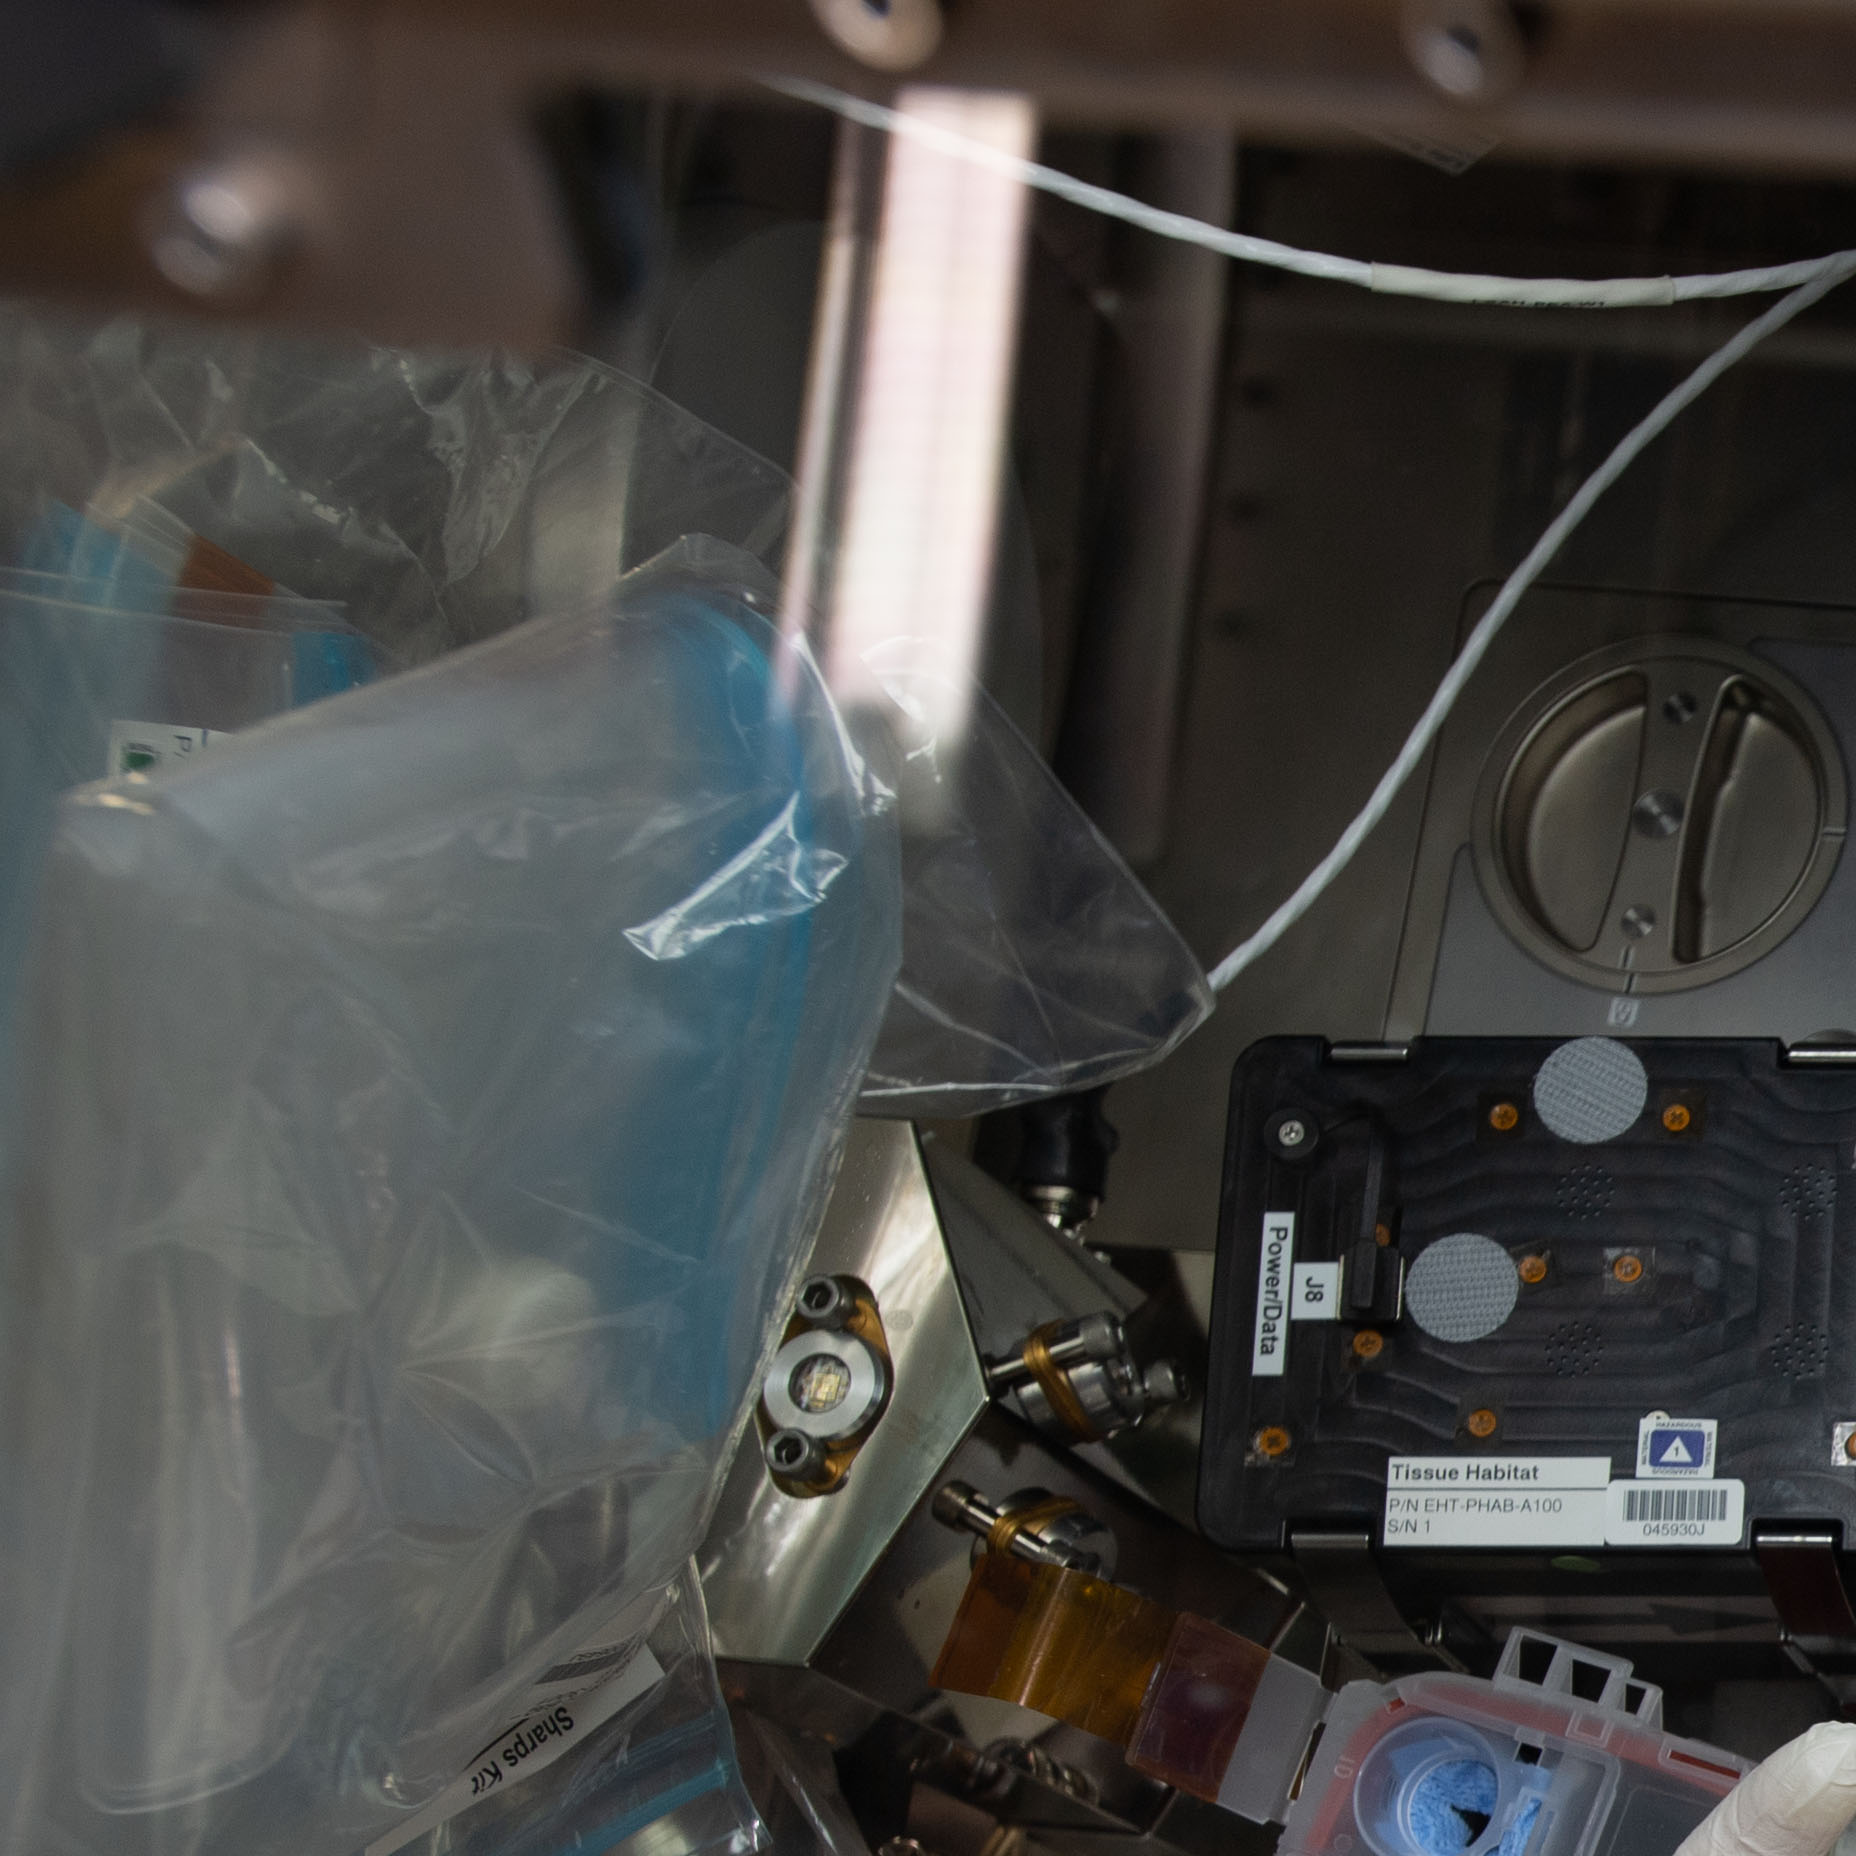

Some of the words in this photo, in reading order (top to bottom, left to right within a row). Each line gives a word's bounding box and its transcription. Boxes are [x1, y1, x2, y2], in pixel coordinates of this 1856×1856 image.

[1259, 1225, 1288, 1356] Power/Data
[1304, 1276, 1324, 1303] J8
[1393, 1465, 1459, 1481] Tissue
[1466, 1464, 1538, 1480] Habitat
[1389, 1498, 1418, 1512] P/N
[1424, 1497, 1562, 1514] EHT-PHAB-A100
[1387, 1519, 1417, 1534] S/N
[1424, 1519, 1431, 1533] 1
[1642, 1523, 1704, 1537] 045930J
[503, 1706, 575, 1767] Sharps
